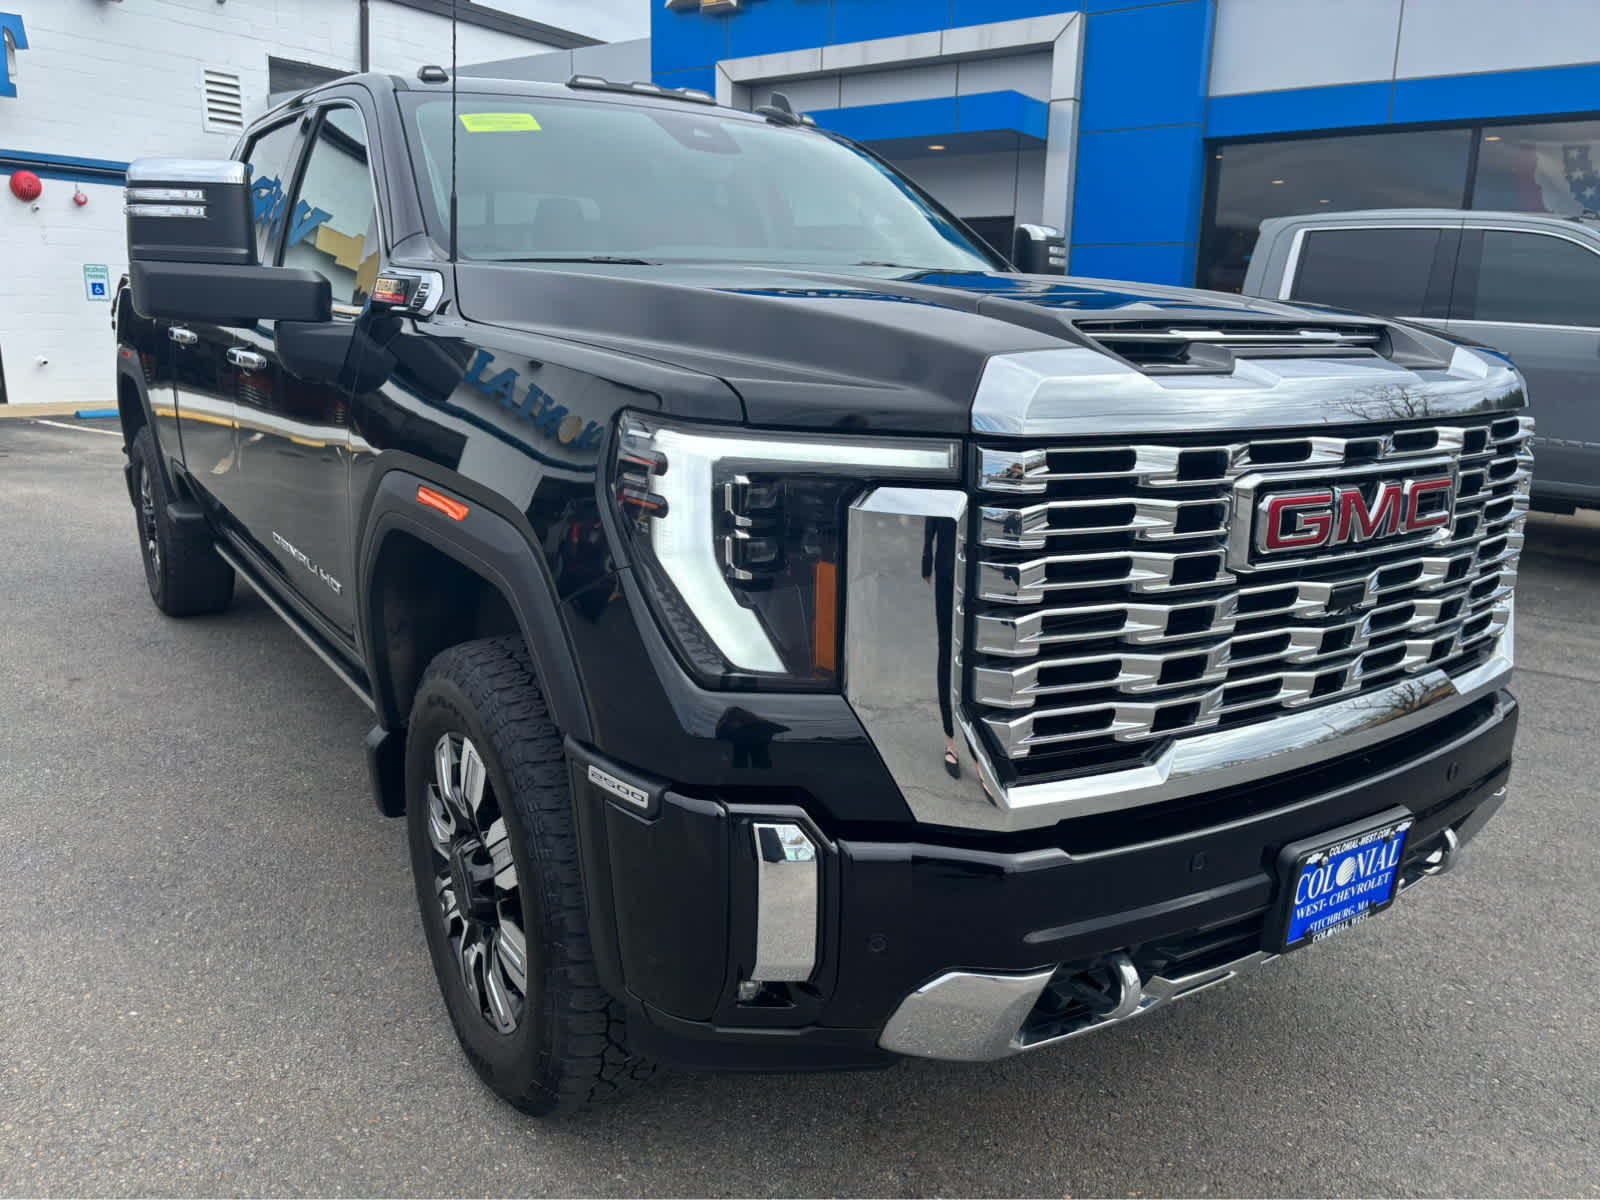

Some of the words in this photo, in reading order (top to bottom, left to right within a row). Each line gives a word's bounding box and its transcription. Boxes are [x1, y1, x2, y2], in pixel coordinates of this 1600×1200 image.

[1257, 479, 1452, 553] GMC
[590, 769, 646, 804] 2500
[1295, 838, 1400, 905] COLONIAL
[1329, 871, 1391, 906] CHEVROLET
[1312, 921, 1349, 944] COLONIAL
